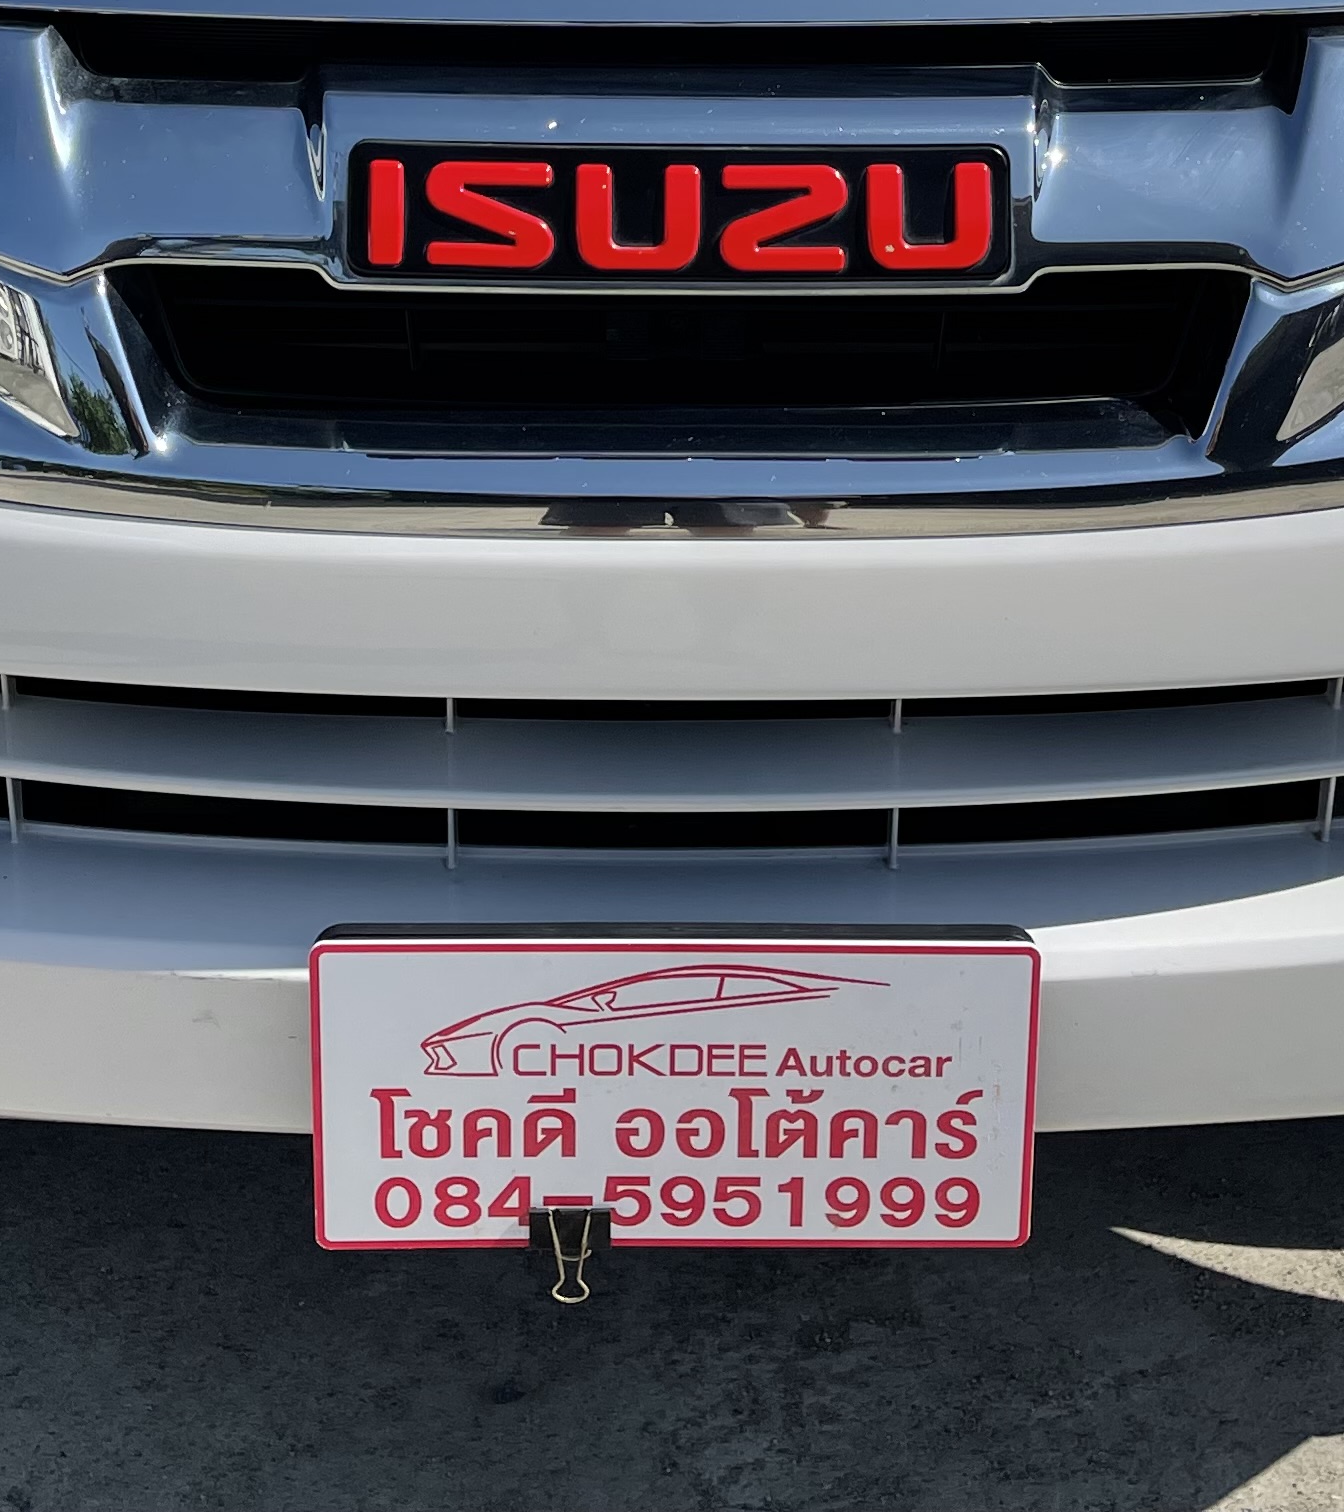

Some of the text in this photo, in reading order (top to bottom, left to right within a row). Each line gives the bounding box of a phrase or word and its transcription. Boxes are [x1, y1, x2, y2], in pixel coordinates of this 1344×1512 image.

[367, 159, 992, 272] ISUZU
[513, 1043, 953, 1078] CHOKDEE Autocar
[370, 1087, 983, 1160] โชคดี ออโต้คาร์
[374, 1175, 981, 1228] 084-5951999
